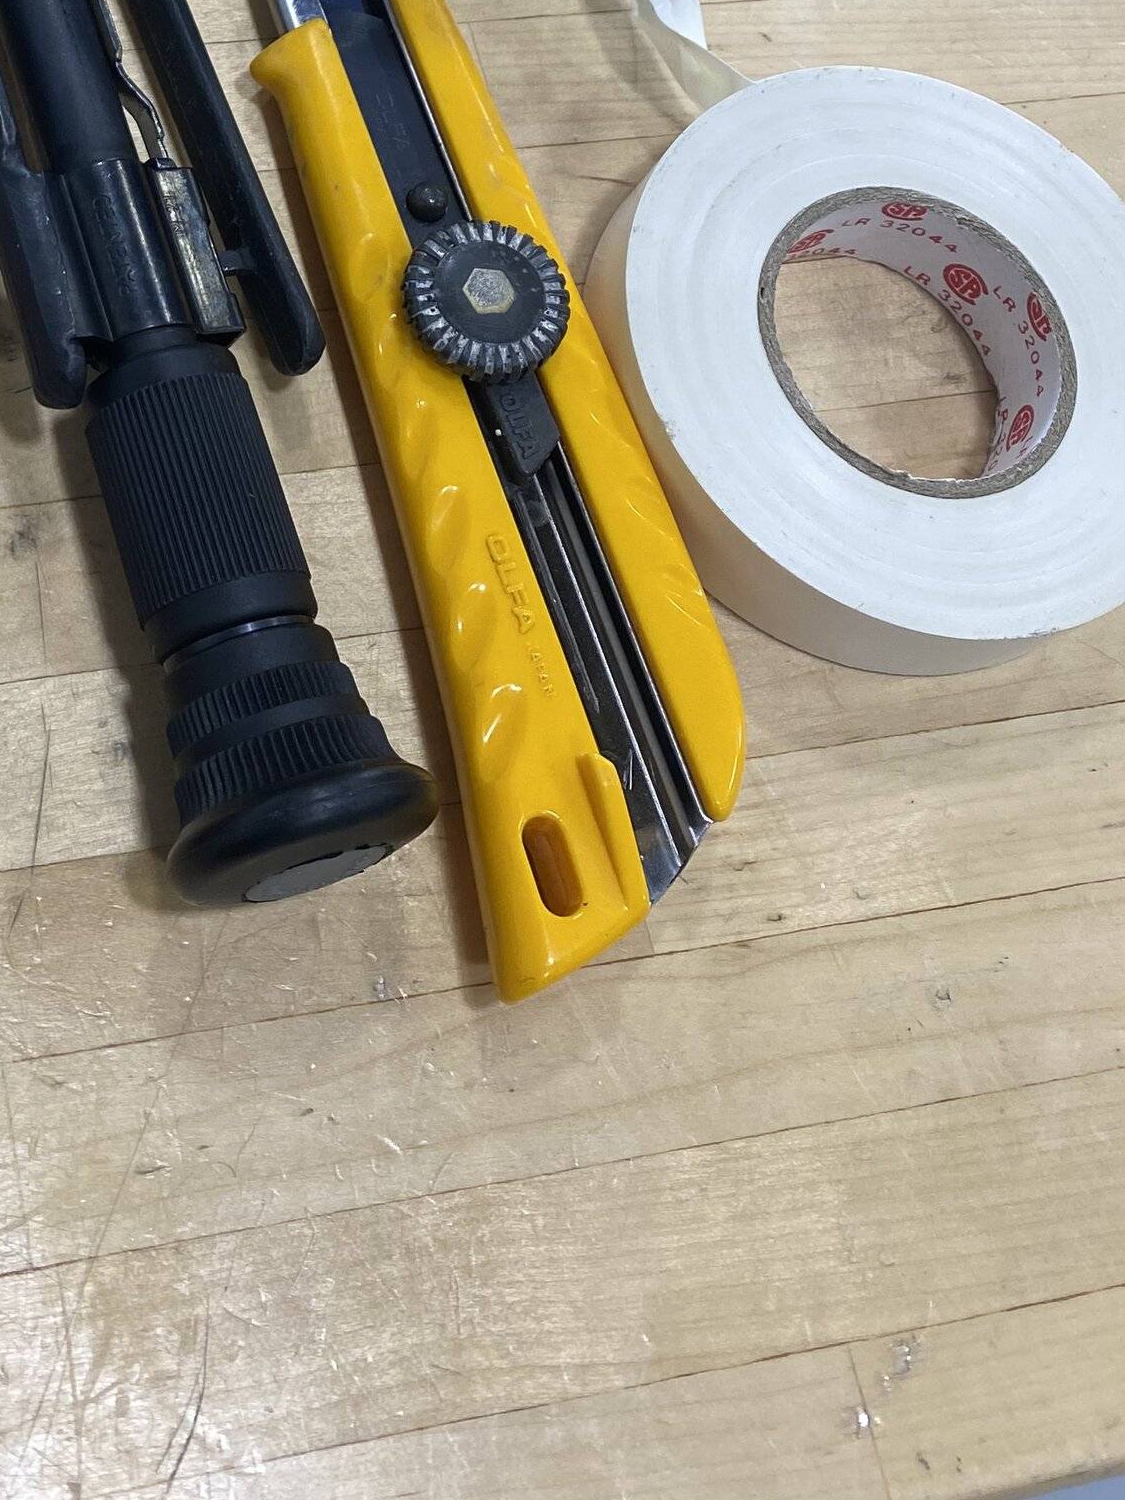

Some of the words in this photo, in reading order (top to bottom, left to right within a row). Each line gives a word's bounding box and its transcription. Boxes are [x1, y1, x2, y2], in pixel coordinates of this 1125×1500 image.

[841, 218, 871, 227] LR
[879, 220, 958, 253] 32044
[903, 265, 931, 286] LR
[938, 289, 992, 357] 32044
[992, 285, 1016, 313] LR
[1017, 320, 1044, 397] 32044
[485, 533, 534, 635] OLFA
